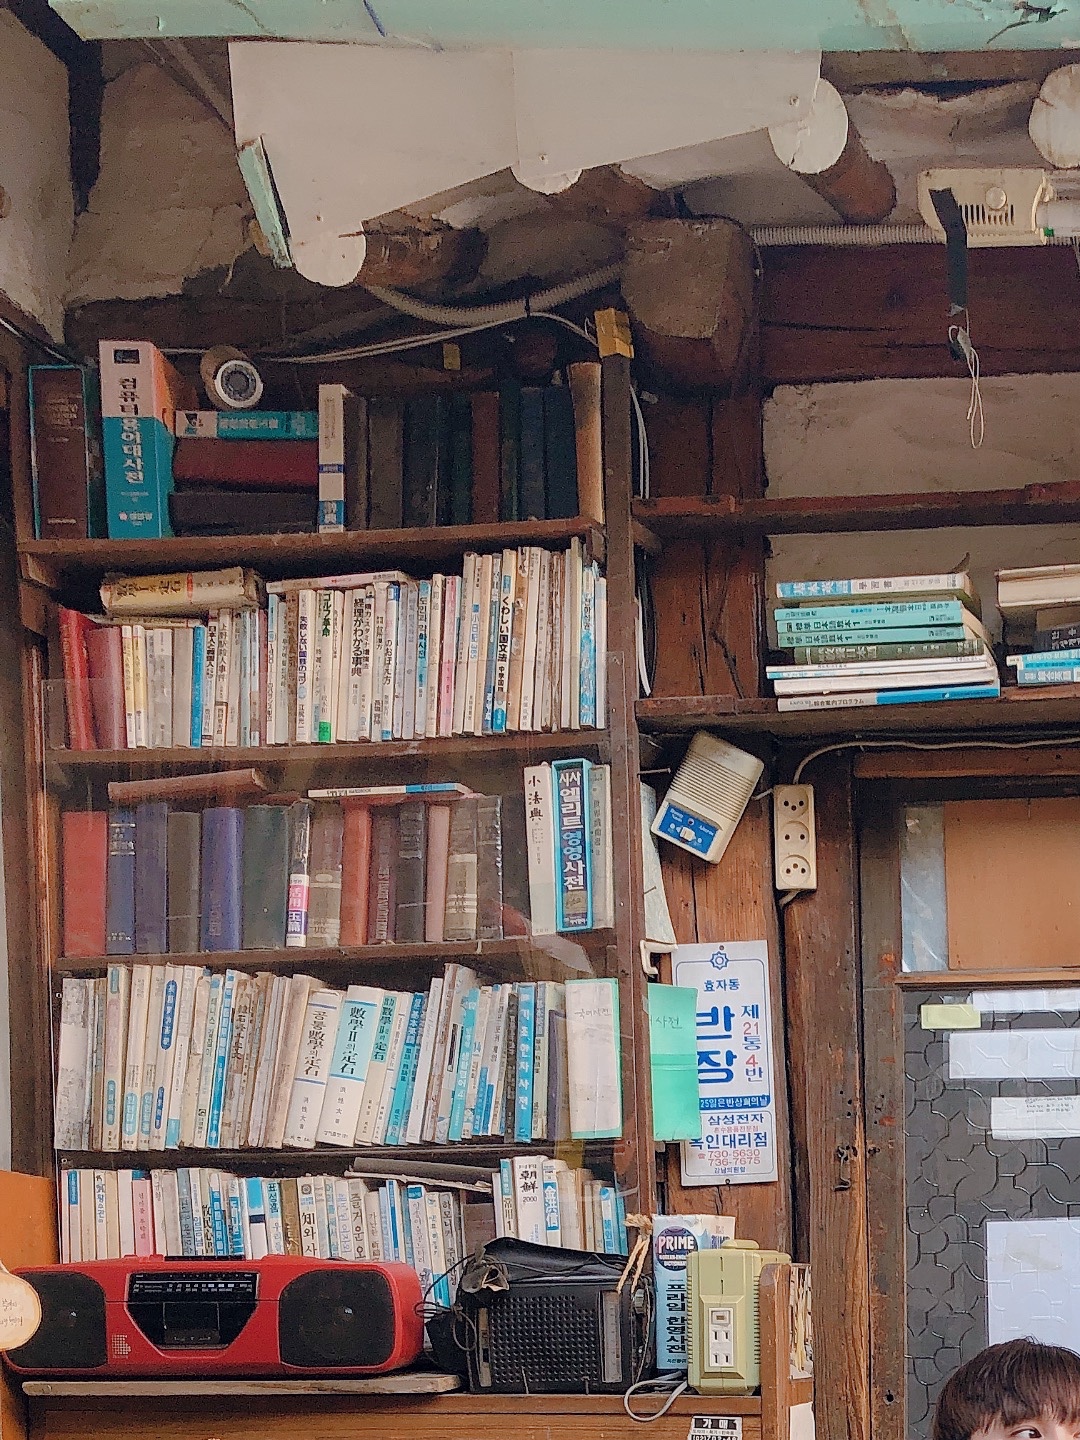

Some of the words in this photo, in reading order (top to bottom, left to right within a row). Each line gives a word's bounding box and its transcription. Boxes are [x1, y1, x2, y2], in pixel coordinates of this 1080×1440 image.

[498, 597, 510, 663] くわしい国文法
[559, 772, 581, 786] 시사
[528, 776, 543, 821] 小法典
[560, 787, 584, 830] 엘리트
[562, 832, 585, 891] 영영사전
[704, 978, 741, 992] 효자동
[708, 1113, 764, 1126] 삼성전자
[708, 1157, 760, 1166] 736-7675
[658, 1235, 694, 1253] PRIME
